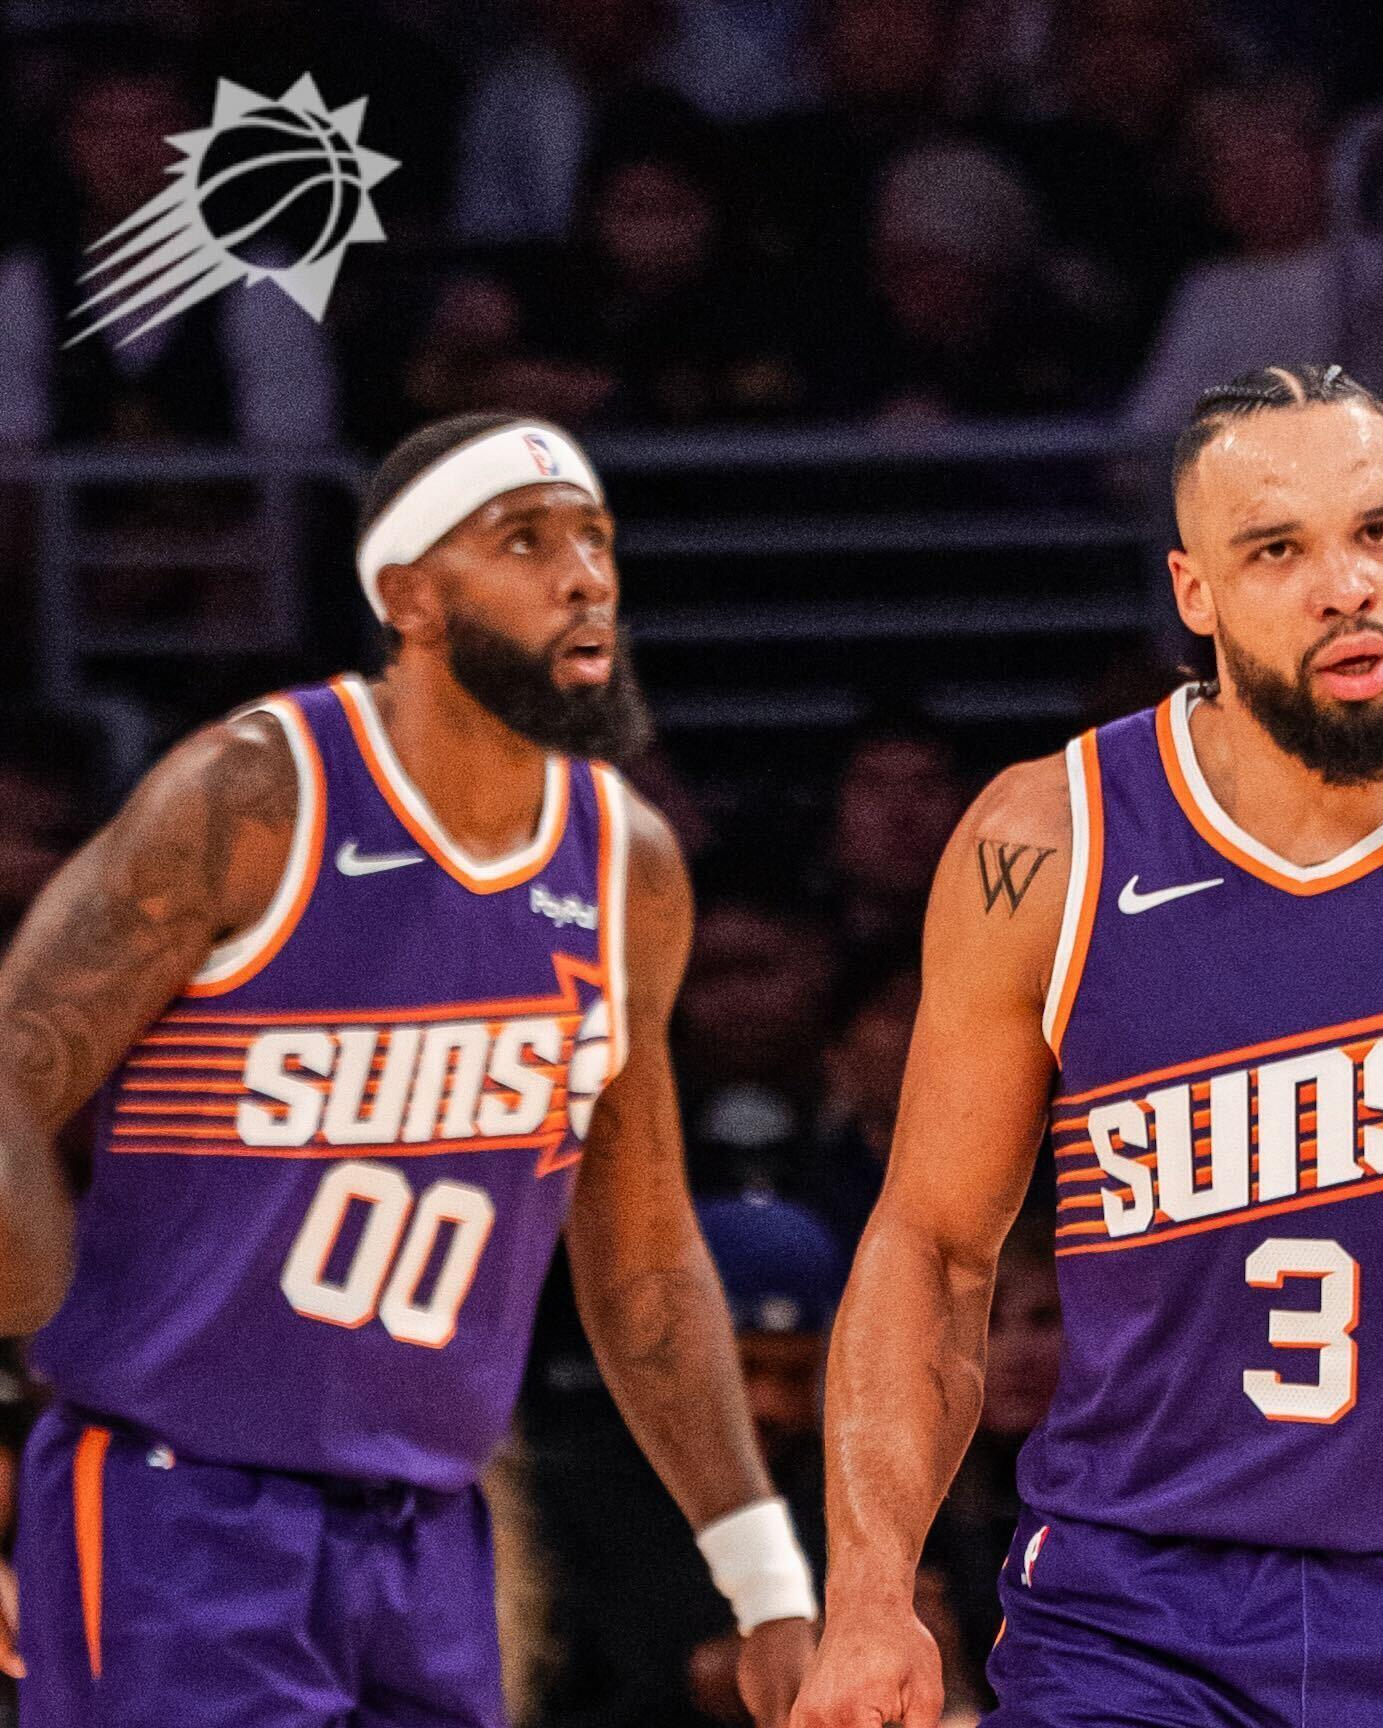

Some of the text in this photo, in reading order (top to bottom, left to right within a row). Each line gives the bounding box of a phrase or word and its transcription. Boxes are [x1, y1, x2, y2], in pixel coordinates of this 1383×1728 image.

[976, 839, 1057, 918] W
[237, 1021, 564, 1146] SUNS
[282, 1161, 494, 1348] 00
[1244, 1238, 1360, 1424] 3
